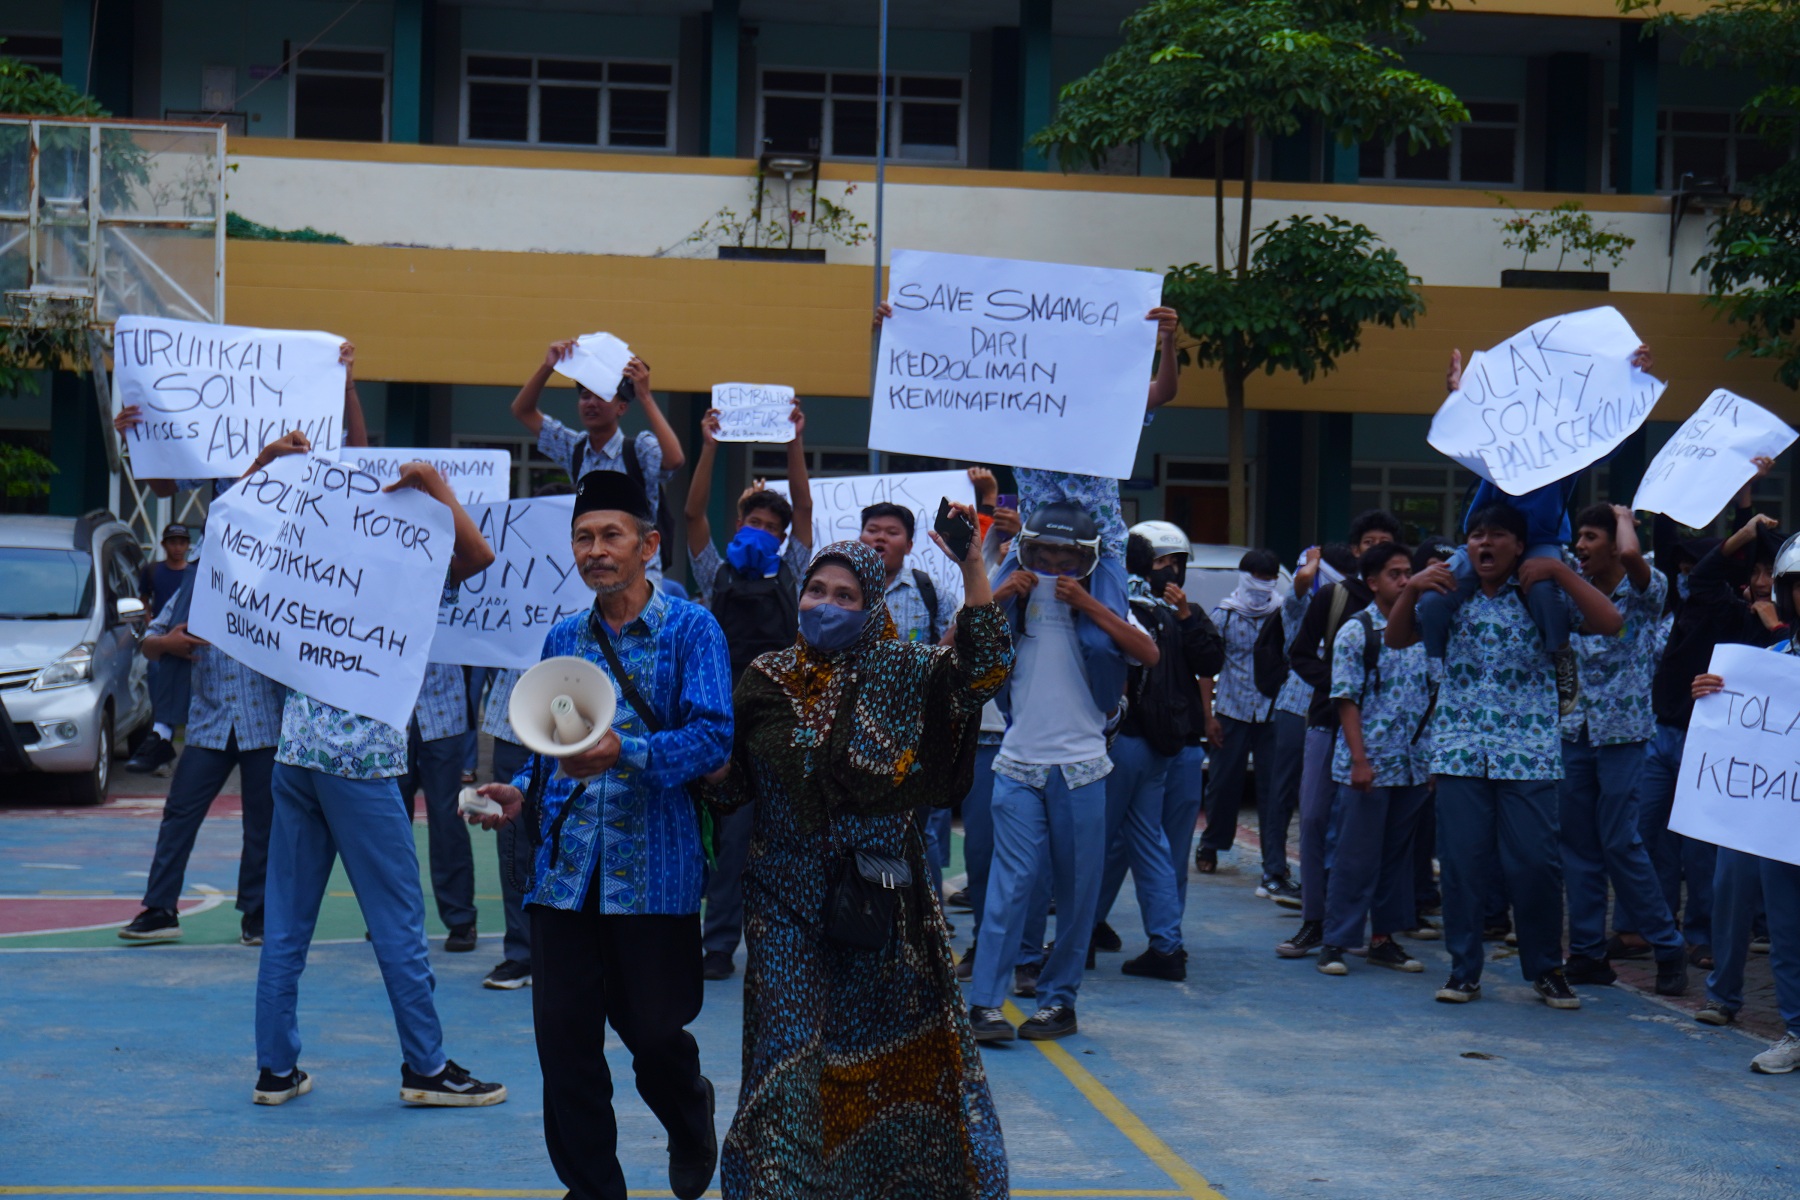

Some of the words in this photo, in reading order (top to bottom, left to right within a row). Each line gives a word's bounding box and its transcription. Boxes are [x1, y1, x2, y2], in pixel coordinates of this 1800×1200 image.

[894, 283, 974, 312] SAVE
[984, 289, 1119, 327] SMAMGA
[116, 329, 282, 371] TURUNKAN
[971, 326, 1027, 359] DARI
[148, 373, 295, 413] SONY
[889, 385, 1067, 418] KEMUNAFIKAN
[1478, 363, 1594, 446] SONY
[813, 477, 925, 511] TOLAK
[353, 505, 433, 562] KOTOR
[211, 566, 224, 595] INI
[226, 612, 280, 651] BUKAN
[299, 642, 380, 678] PARPOL
